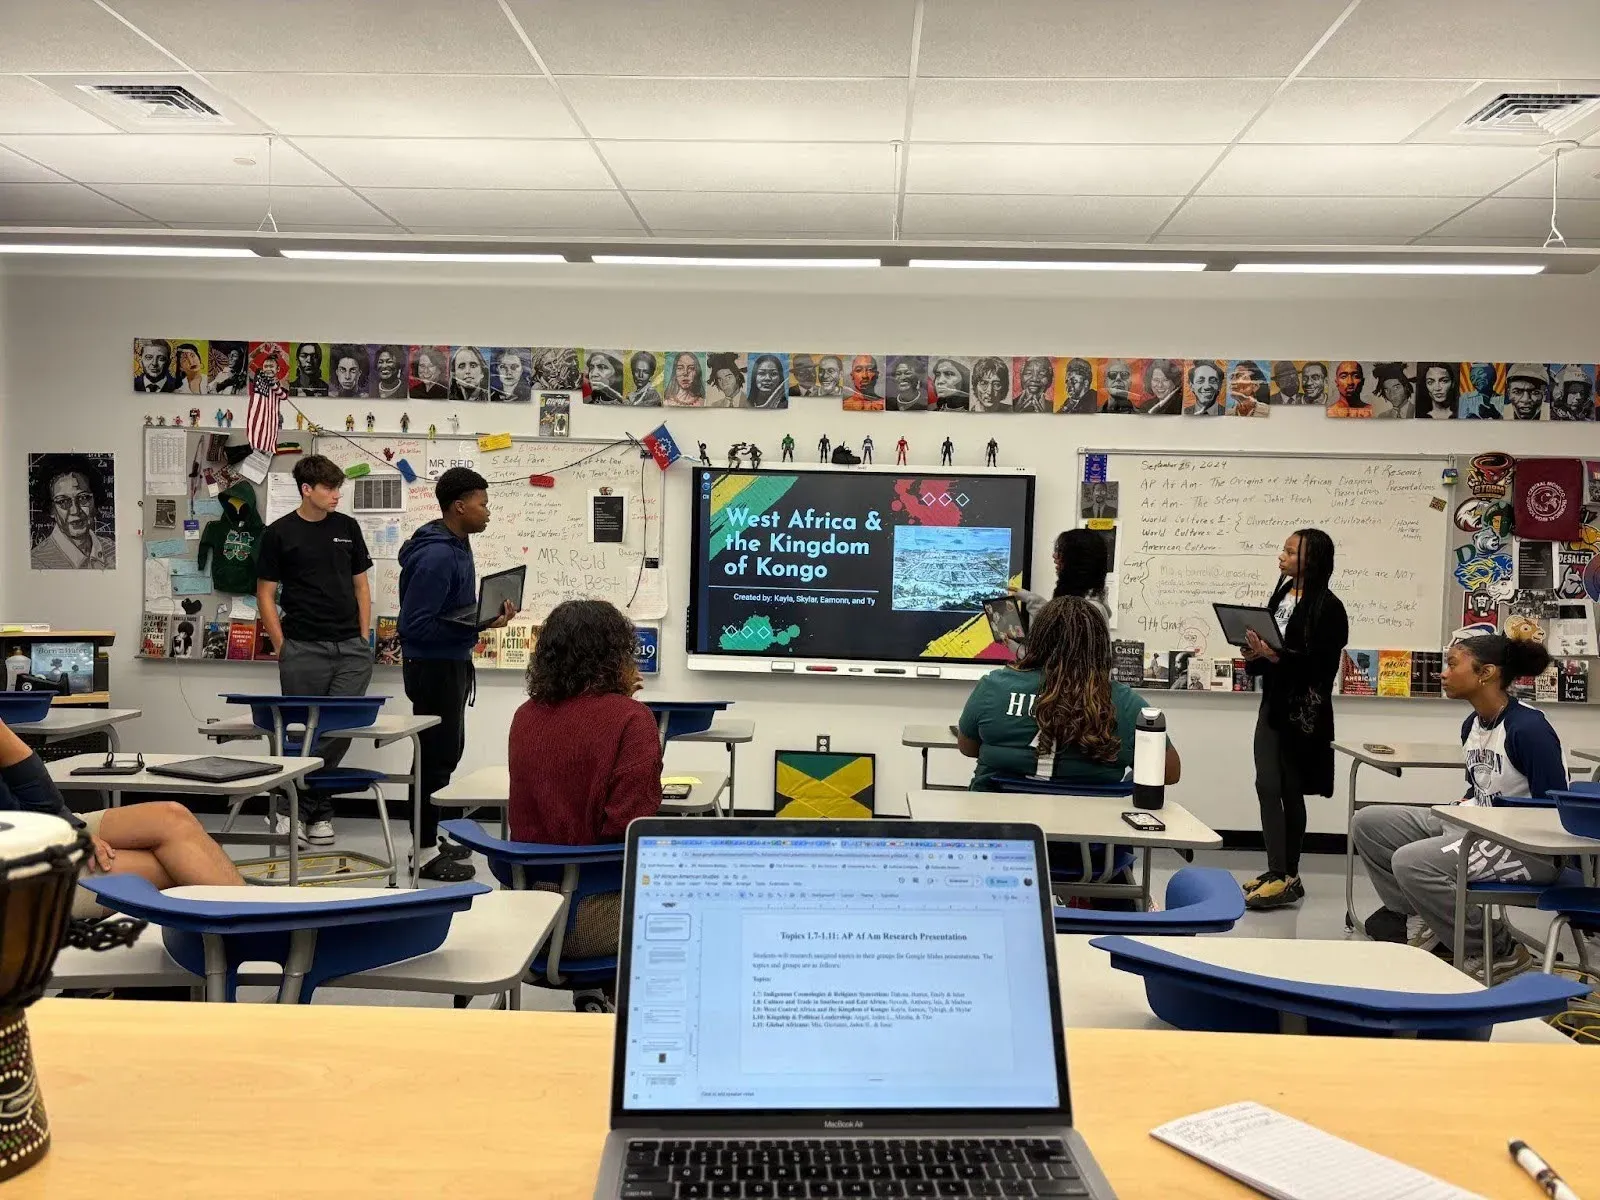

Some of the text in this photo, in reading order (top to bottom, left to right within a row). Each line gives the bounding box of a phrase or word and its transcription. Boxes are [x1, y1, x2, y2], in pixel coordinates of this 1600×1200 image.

[429, 459, 474, 468] MR. REID
[1199, 460, 1228, 470] 2024
[1364, 464, 1423, 478] AP Research
[1140, 479, 1157, 490] AP
[1210, 476, 1226, 487] The
[1285, 475, 1298, 485] the
[1386, 479, 1436, 492] Presentations
[1474, 484, 1505, 494] STORM
[1191, 496, 1209, 508] The
[725, 507, 883, 531] West Africa &
[1141, 514, 1167, 523] World
[1141, 528, 1167, 537] World
[725, 531, 870, 559] the Kingdom
[1141, 541, 1181, 552] American
[1239, 541, 1254, 550] The
[570, 549, 606, 571] Reid
[1558, 553, 1590, 565] DESALES
[723, 554, 828, 582] of Kongo
[1341, 568, 1415, 580] people are NOT
[733, 593, 876, 607] Created by: Kayla, Skylar, Eamonn, and Ty
[1137, 615, 1158, 631] 9th
[505, 626, 527, 637] JUST
[501, 637, 530, 649] ACTION
[1115, 645, 1140, 655] Caste
[1565, 675, 1585, 684] Martin
[779, 931, 967, 941] Topics 1.7-1.11: AP Af Am Research Presentation
[824, 1120, 864, 1129] MacBook Air
